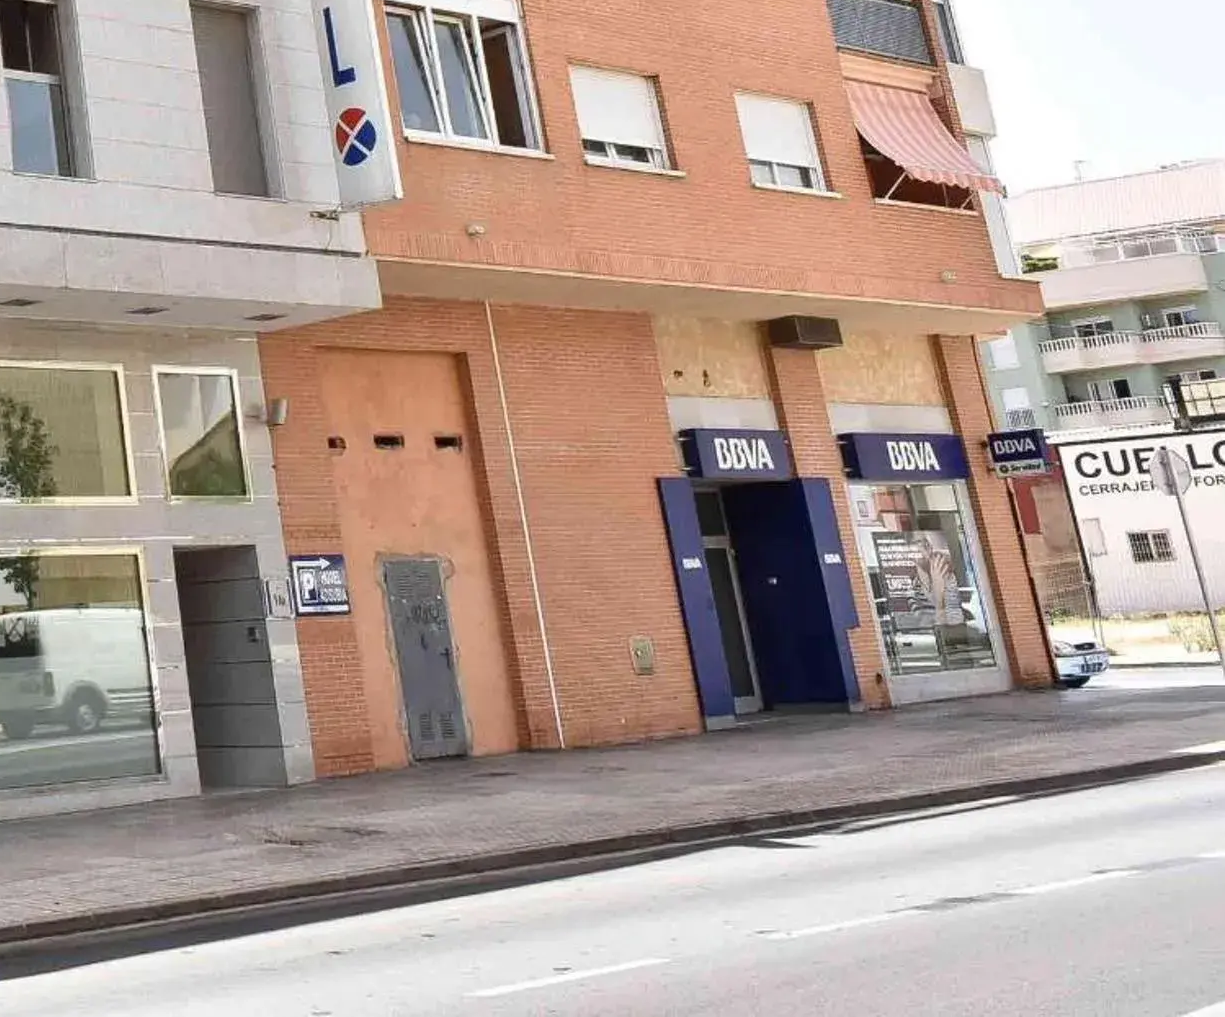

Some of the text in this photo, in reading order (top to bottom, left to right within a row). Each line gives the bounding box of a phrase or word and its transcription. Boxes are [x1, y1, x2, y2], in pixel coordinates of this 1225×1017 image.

[714, 437, 775, 470] BBVA
[886, 441, 941, 471] BBVA
[993, 437, 1037, 455] BBVA
